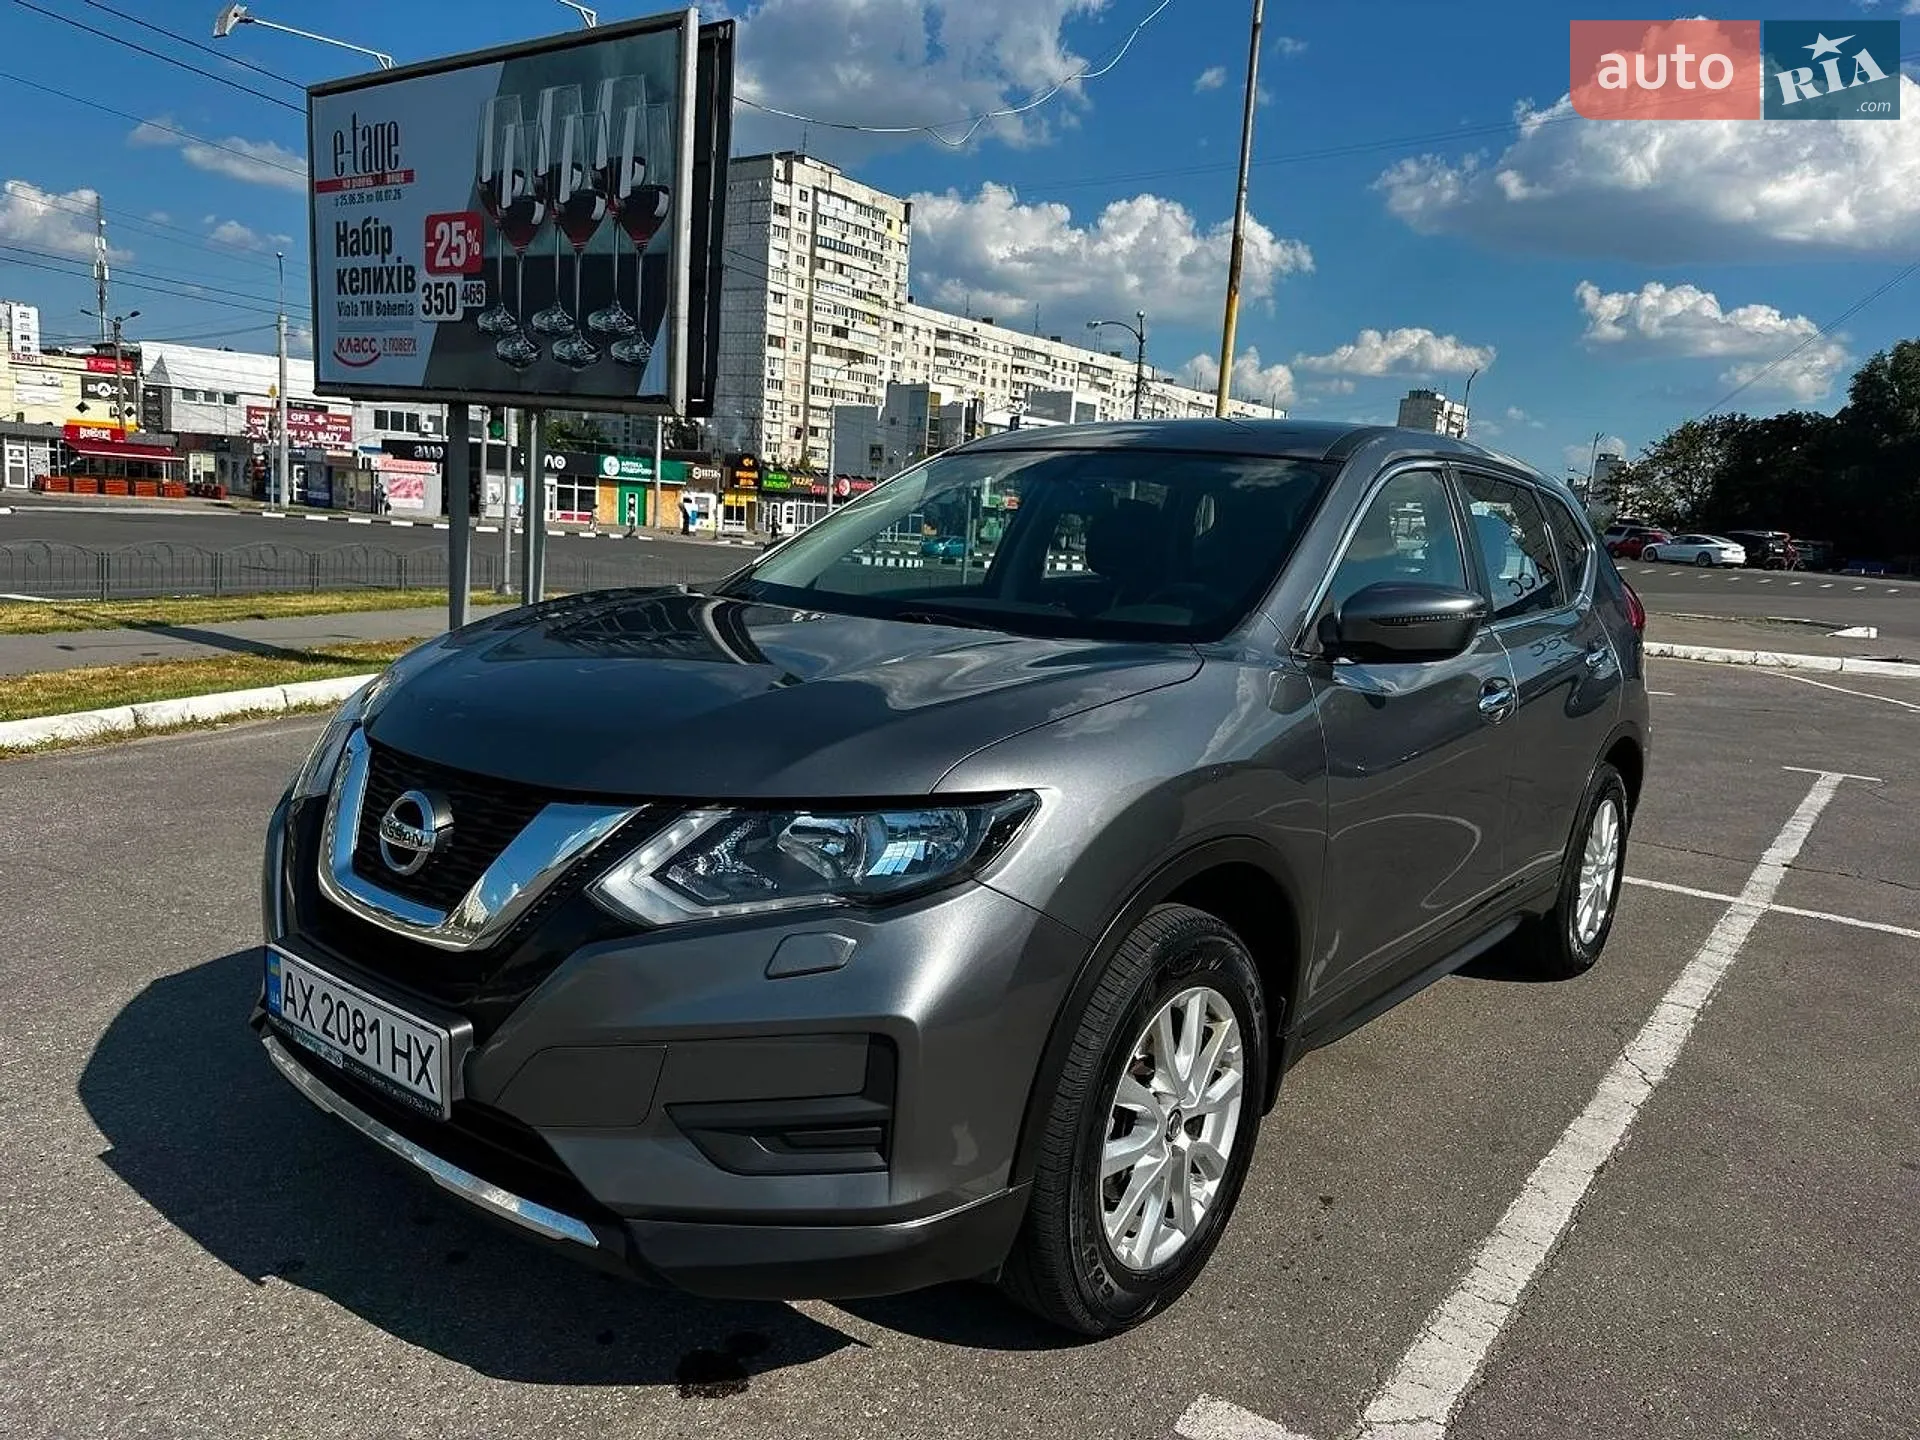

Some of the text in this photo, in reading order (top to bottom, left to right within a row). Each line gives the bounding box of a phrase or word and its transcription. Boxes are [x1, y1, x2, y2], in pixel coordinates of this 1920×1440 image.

[333, 112, 400, 177] e-tage
[335, 215, 393, 263] Набір
[426, 221, 480, 268] -25%
[336, 256, 416, 296] келихів
[421, 281, 457, 315] 350
[284, 971, 316, 1029] AX
[321, 992, 381, 1065] 2081
[391, 1025, 436, 1094] HX
